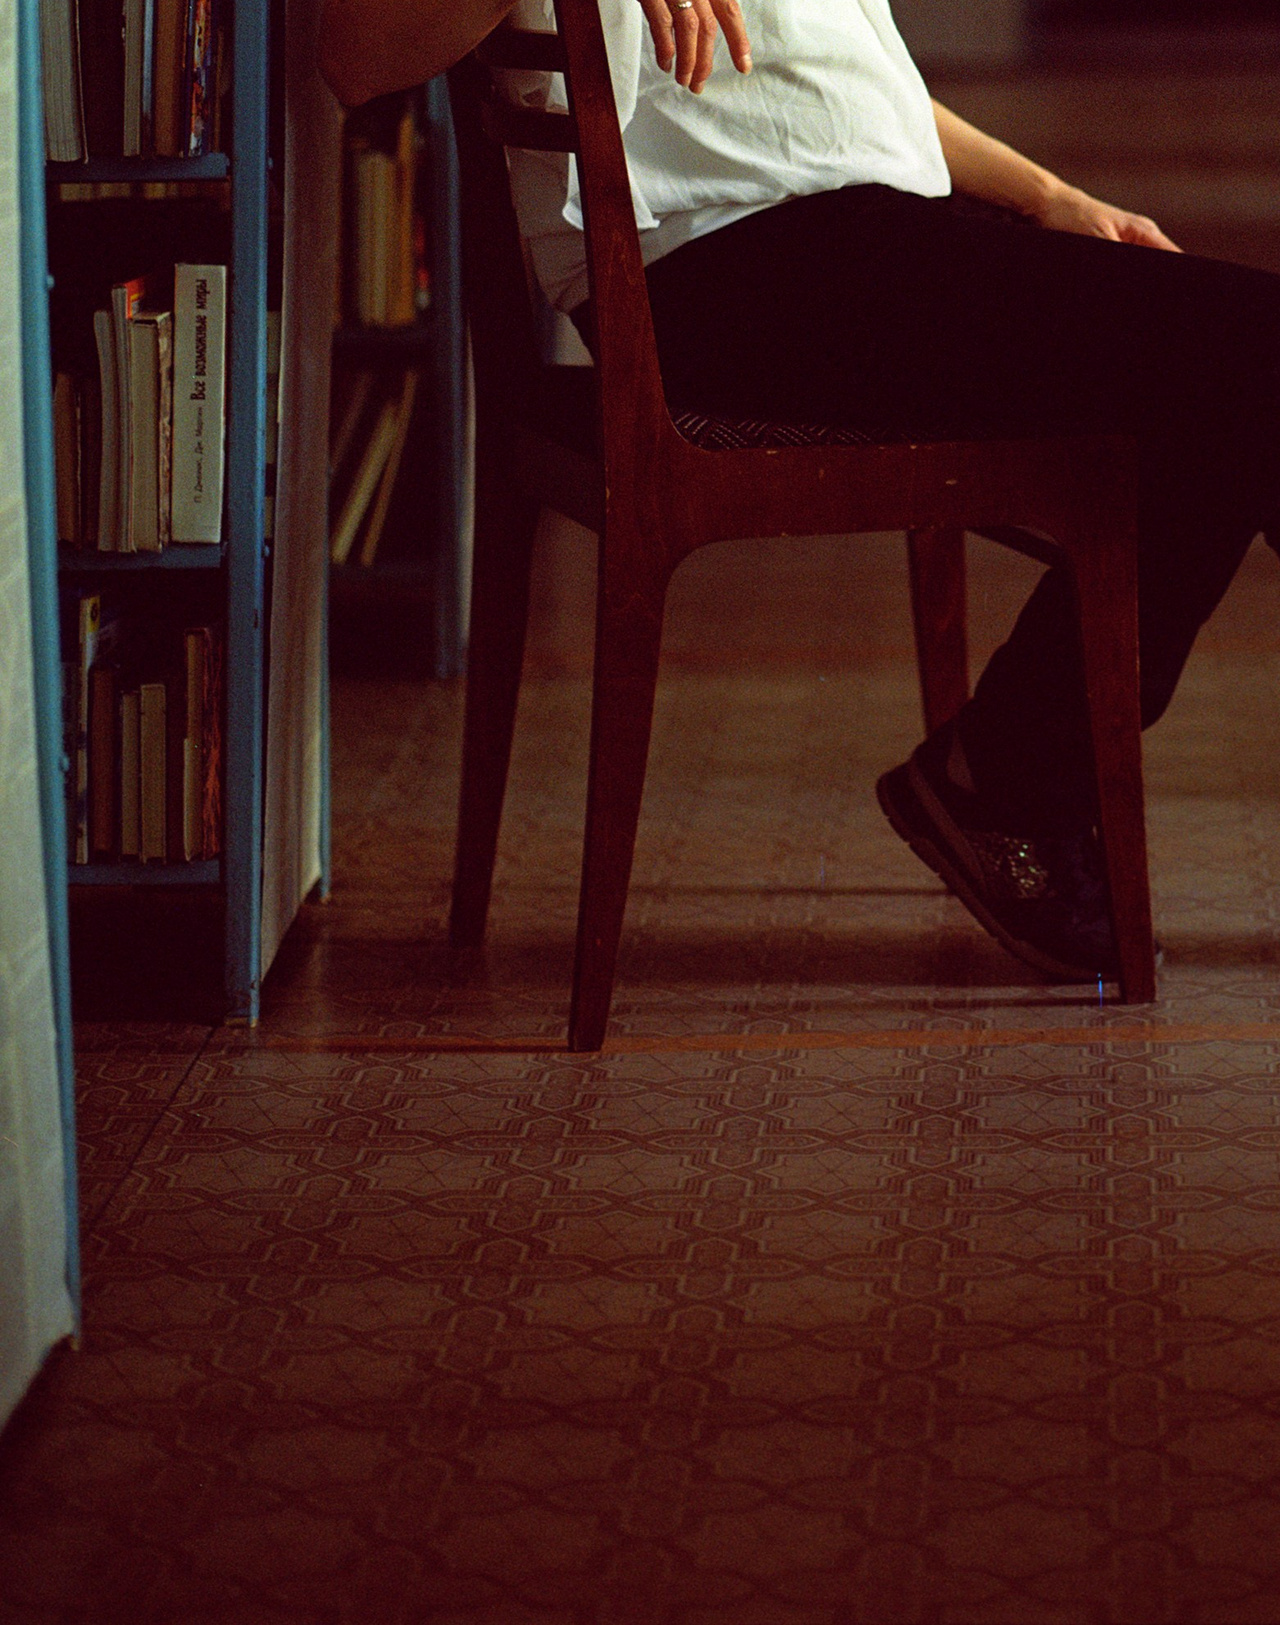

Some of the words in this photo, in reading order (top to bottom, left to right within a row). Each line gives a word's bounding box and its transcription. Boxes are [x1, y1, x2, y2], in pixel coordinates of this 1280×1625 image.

[195, 278, 210, 310] миры
[194, 314, 207, 378] возможные
[189, 381, 207, 401] Все
